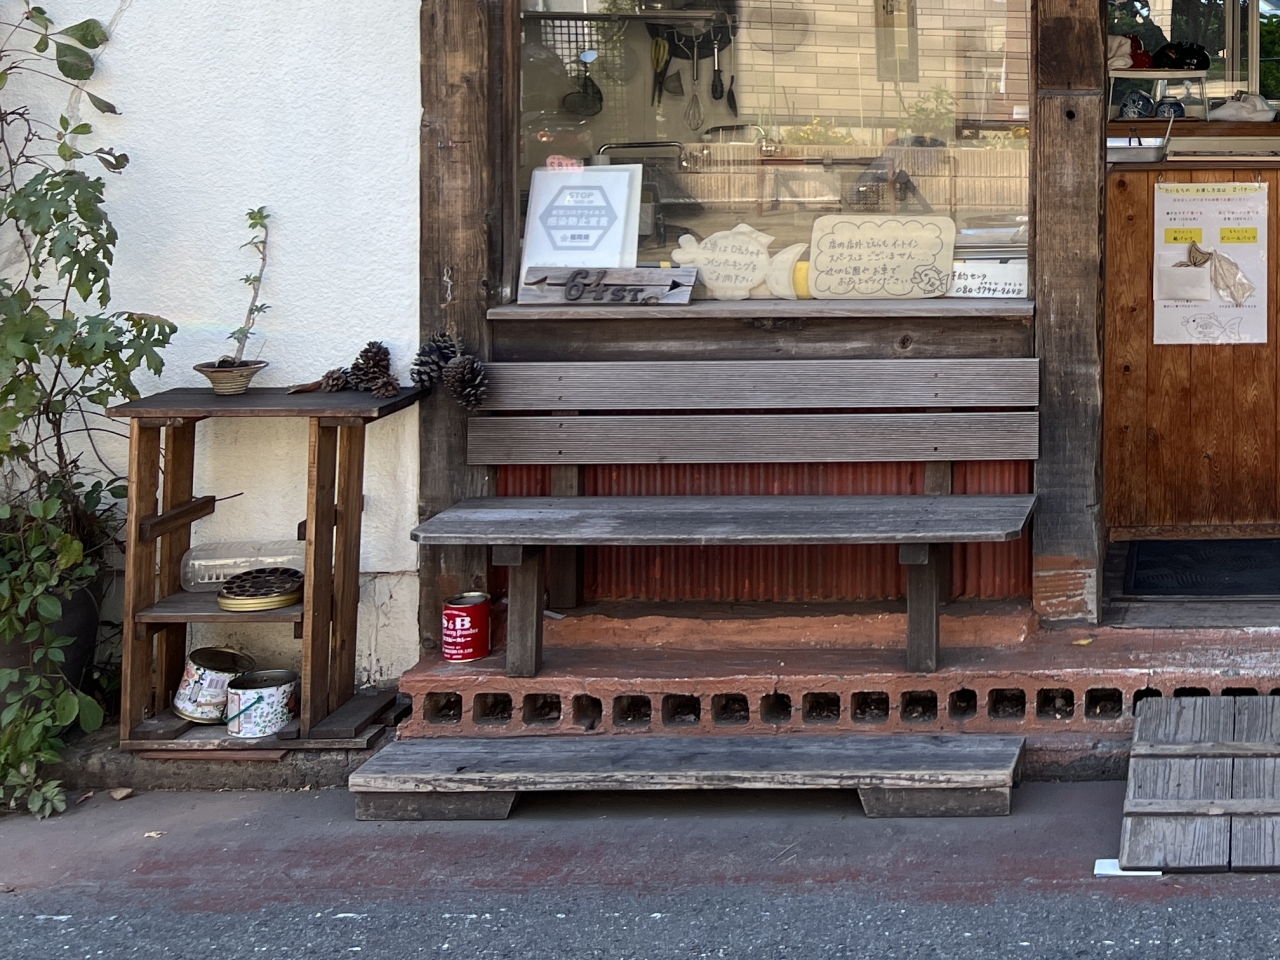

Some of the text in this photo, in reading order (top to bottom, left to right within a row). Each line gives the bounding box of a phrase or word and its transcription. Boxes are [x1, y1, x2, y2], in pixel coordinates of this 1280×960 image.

[568, 191, 594, 199] STOP
[547, 216, 609, 227] 感染防止宣言
[564, 269, 608, 301] 64
